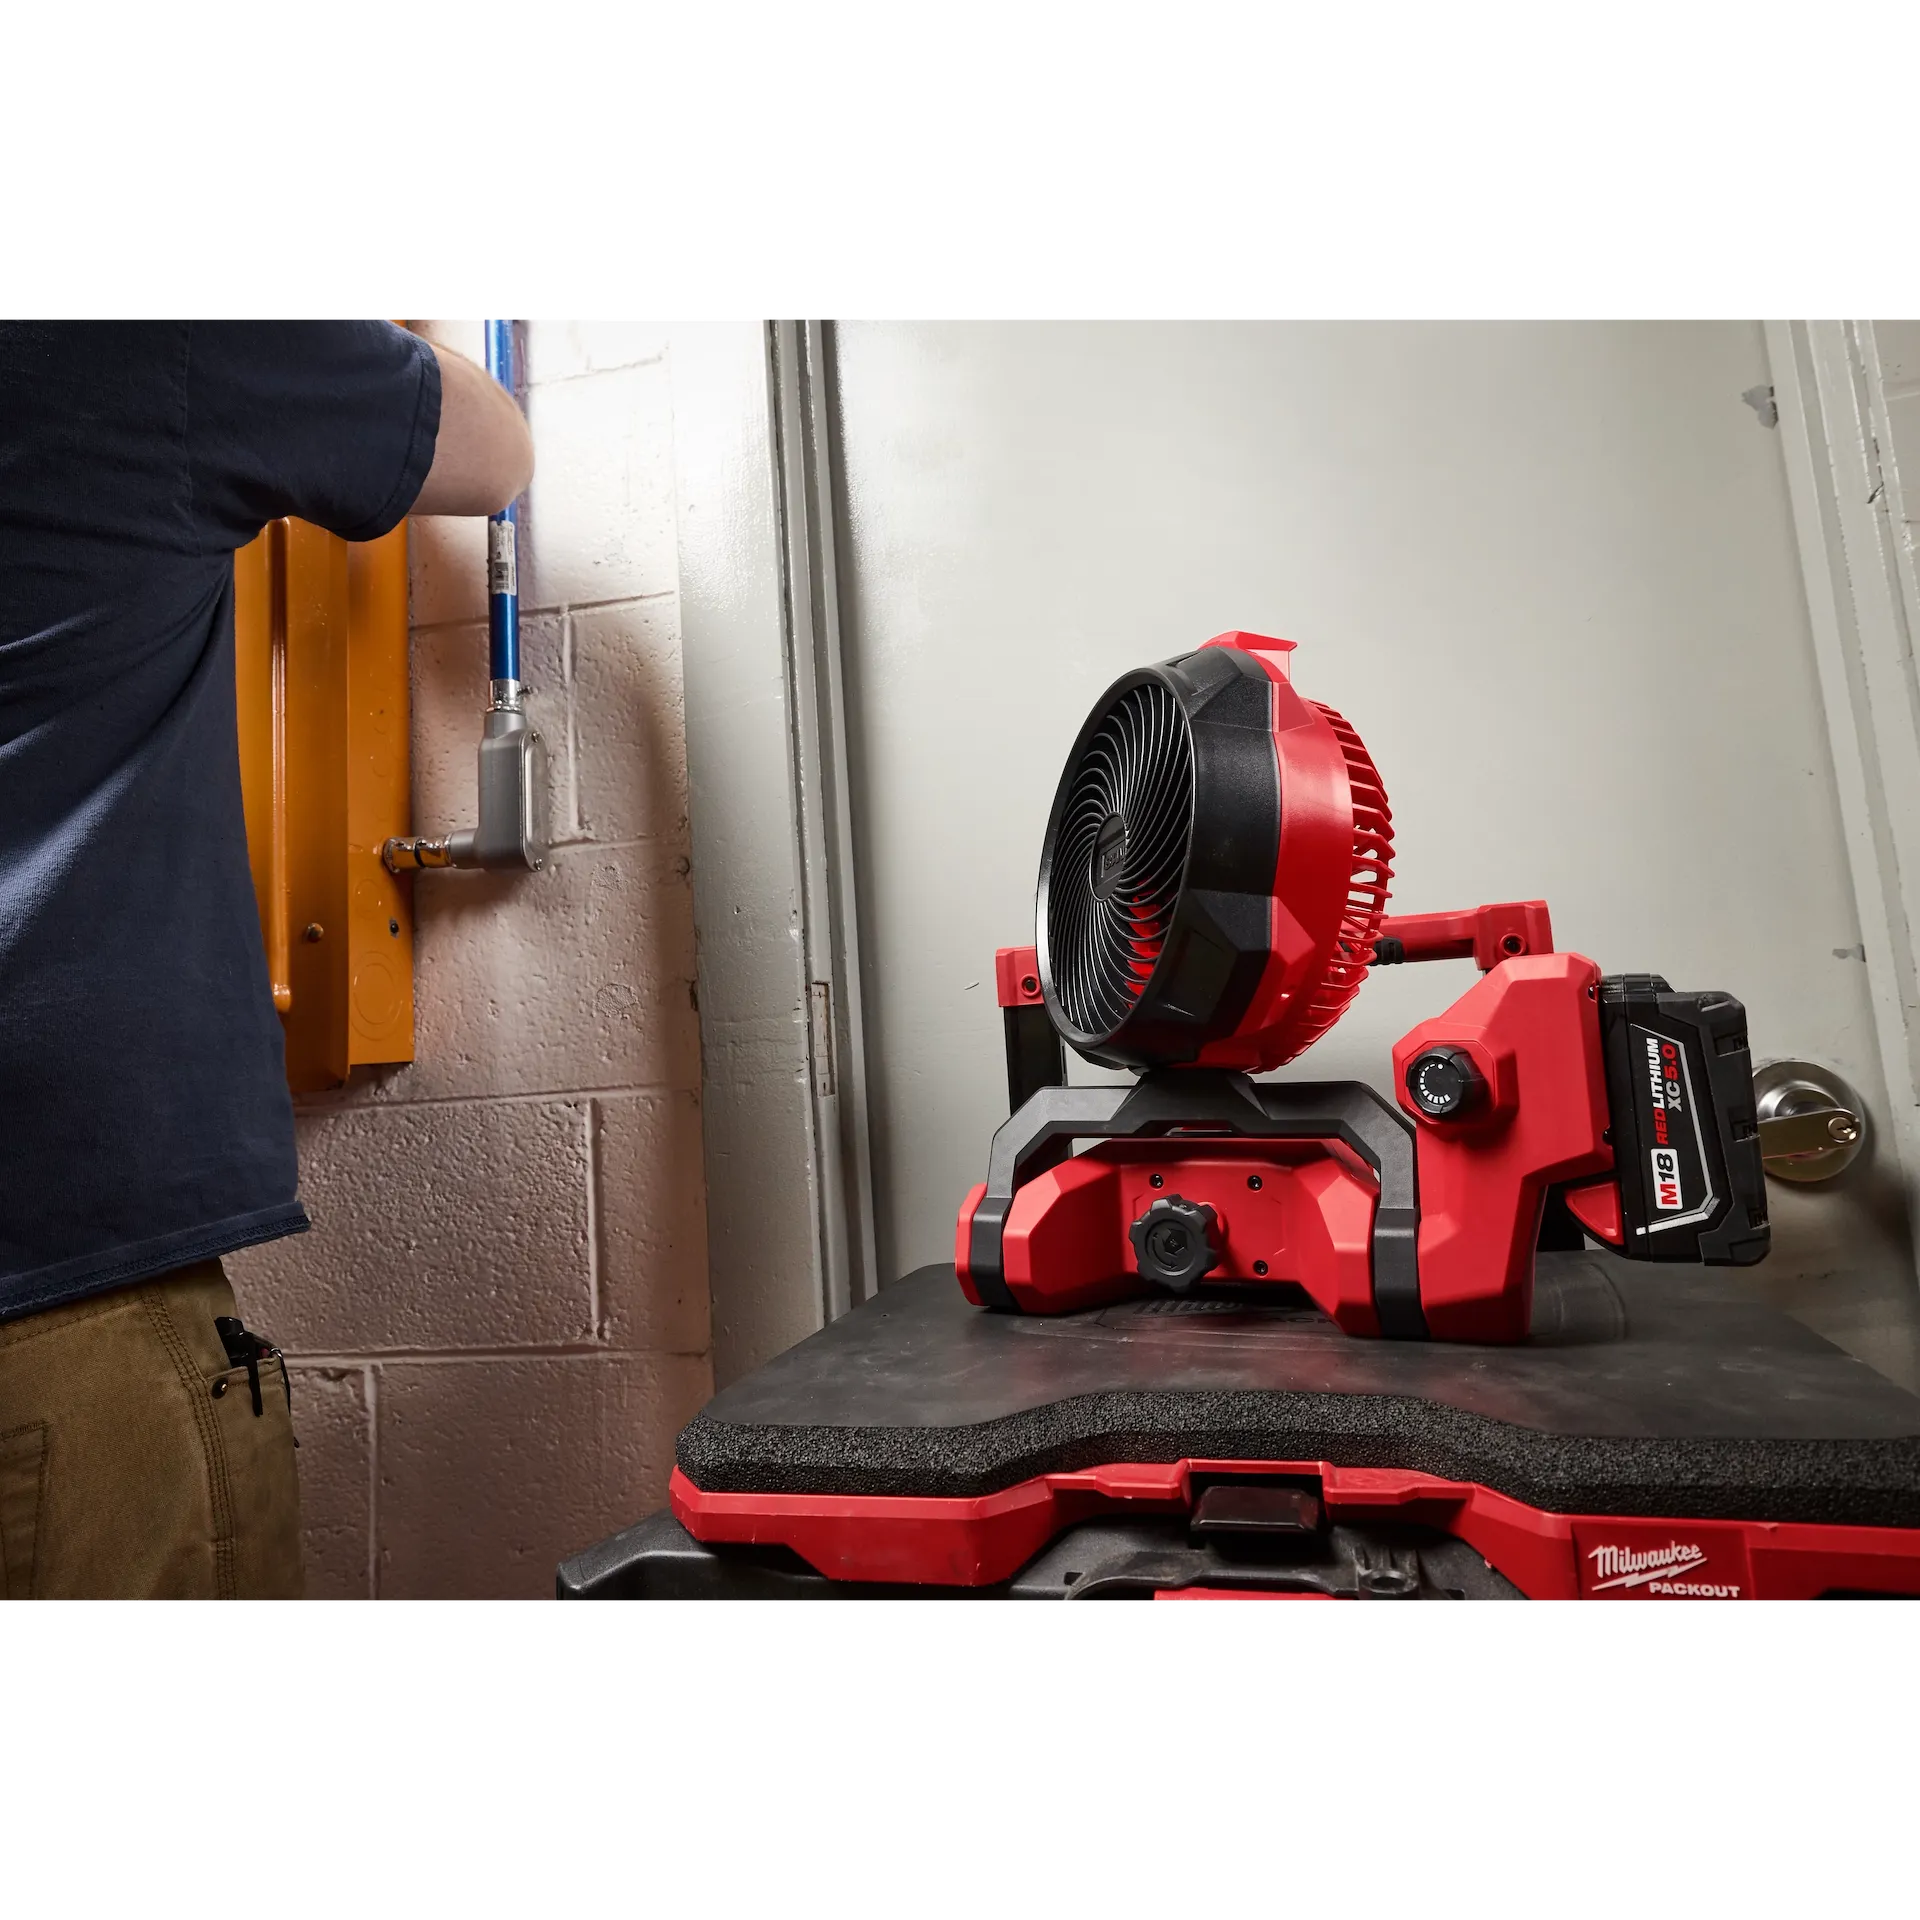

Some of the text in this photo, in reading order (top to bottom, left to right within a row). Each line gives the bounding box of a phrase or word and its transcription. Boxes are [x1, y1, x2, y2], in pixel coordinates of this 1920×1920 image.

[1646, 1037, 1669, 1146] REDLITHIUM
[1656, 1152, 1678, 1205] M18
[1588, 1540, 1703, 1579] Milwaukee
[1649, 1582, 1741, 1598] PACKOUT
